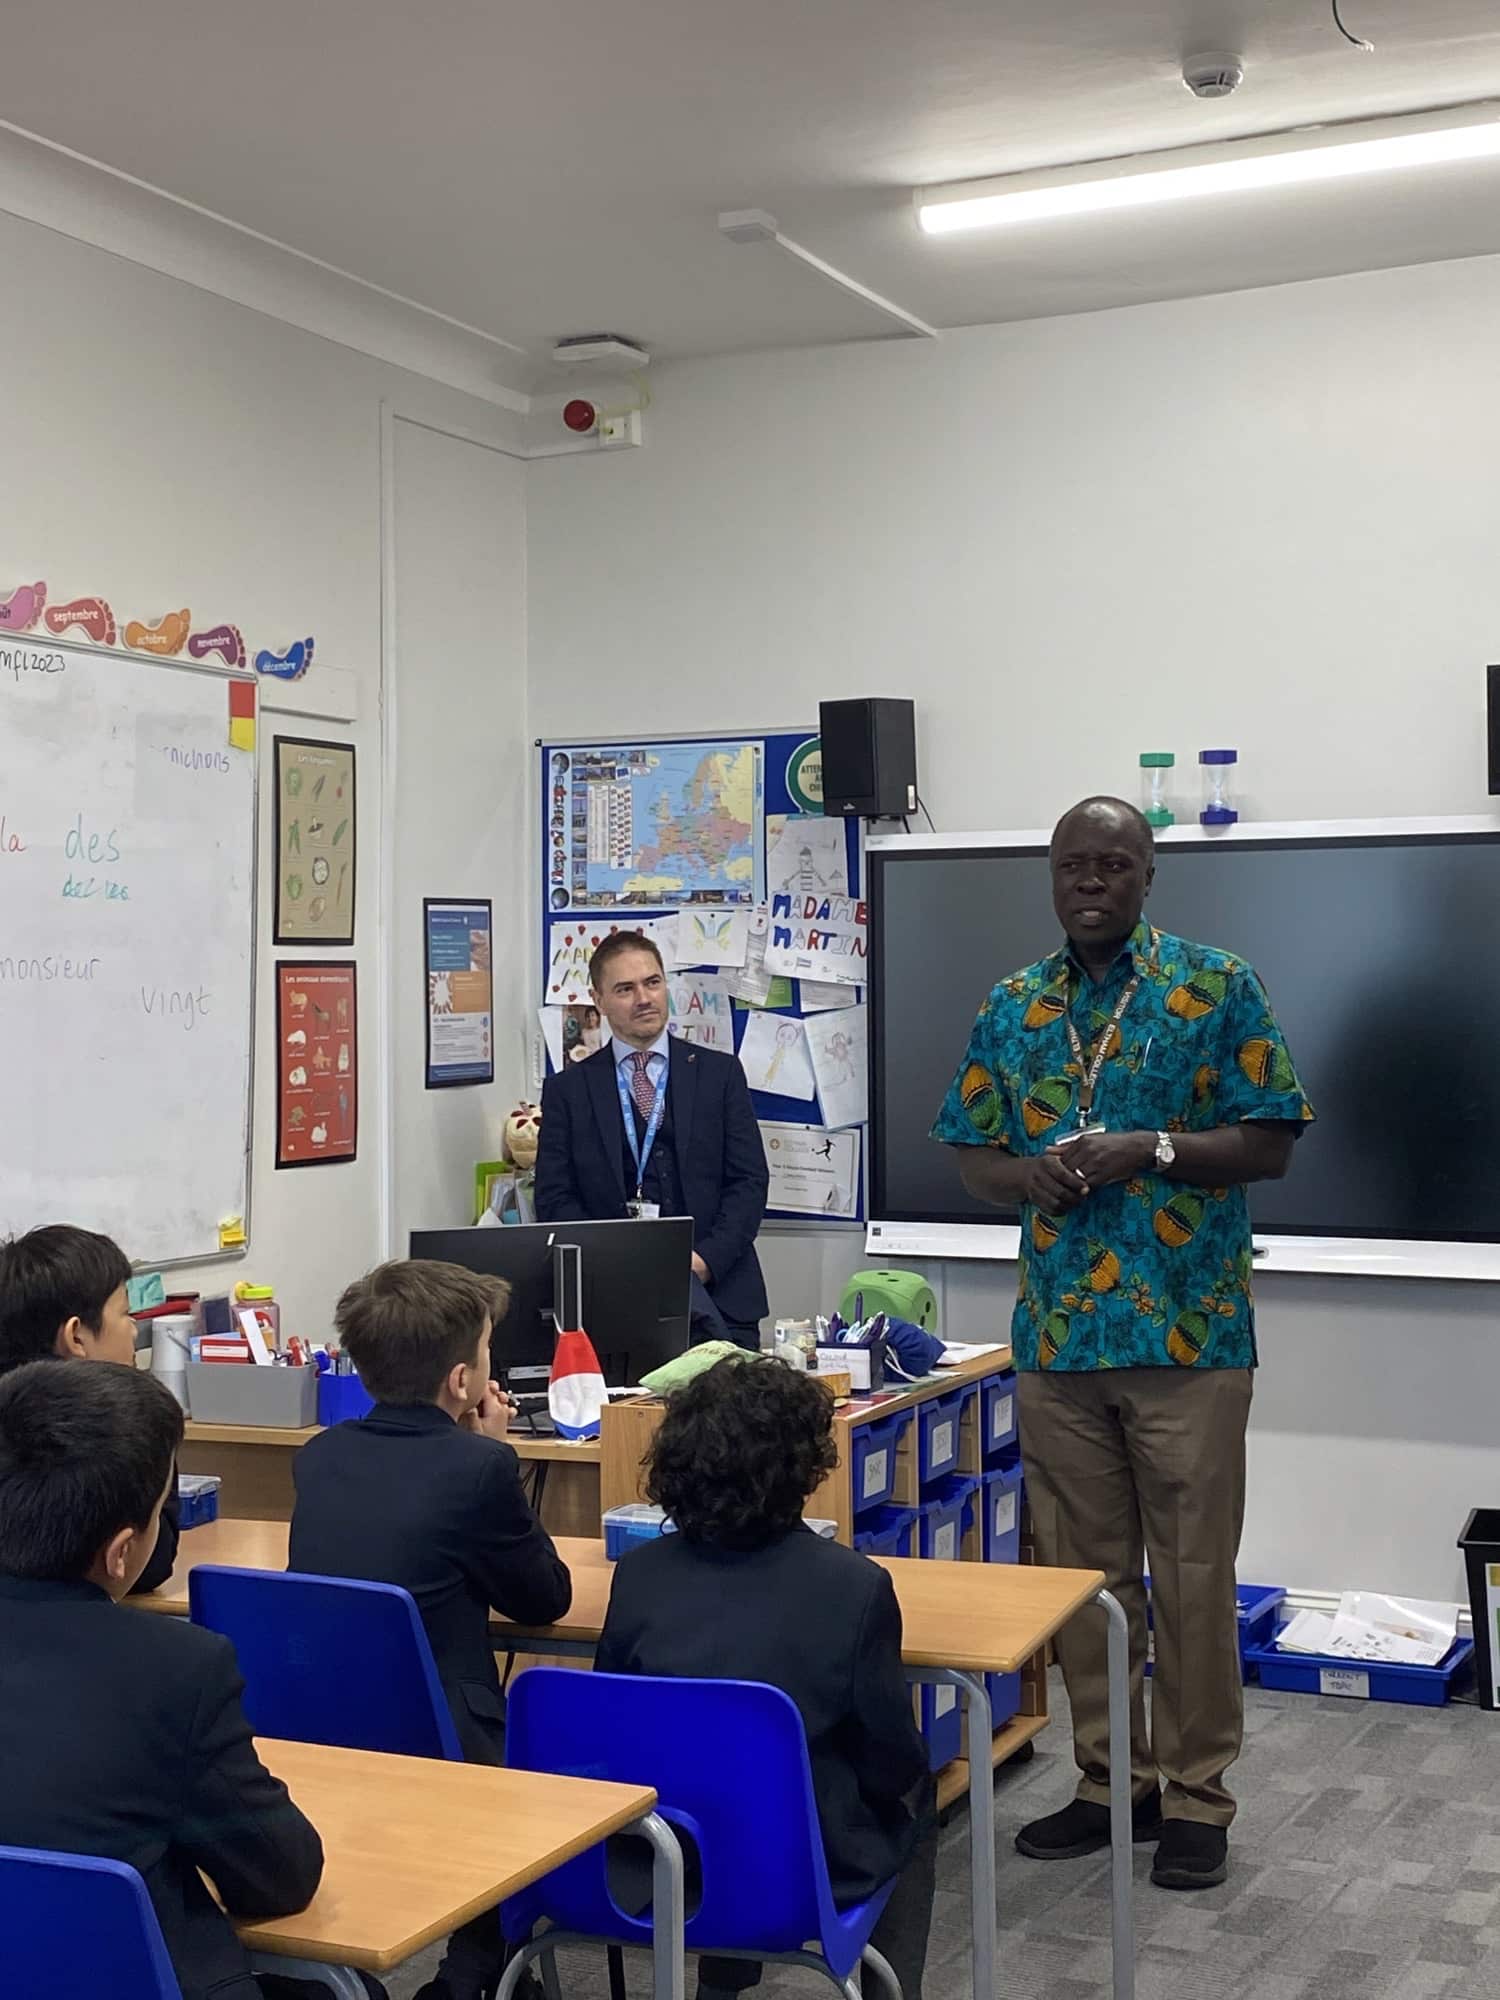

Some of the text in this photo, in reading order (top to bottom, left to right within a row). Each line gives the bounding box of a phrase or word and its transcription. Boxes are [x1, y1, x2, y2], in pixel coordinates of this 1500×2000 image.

[53, 608, 99, 625] septembre
[136, 634, 168, 646] octobre
[197, 635, 232, 649] novembre
[262, 660, 297, 672] décembre
[65, 812, 121, 863] des
[771, 893, 870, 925] MADAME
[772, 926, 870, 958] MARTIN
[0, 955, 102, 981] monsieur
[1113, 991, 1133, 1021] VISITOR
[1100, 1023, 1117, 1056] ELTHAM
